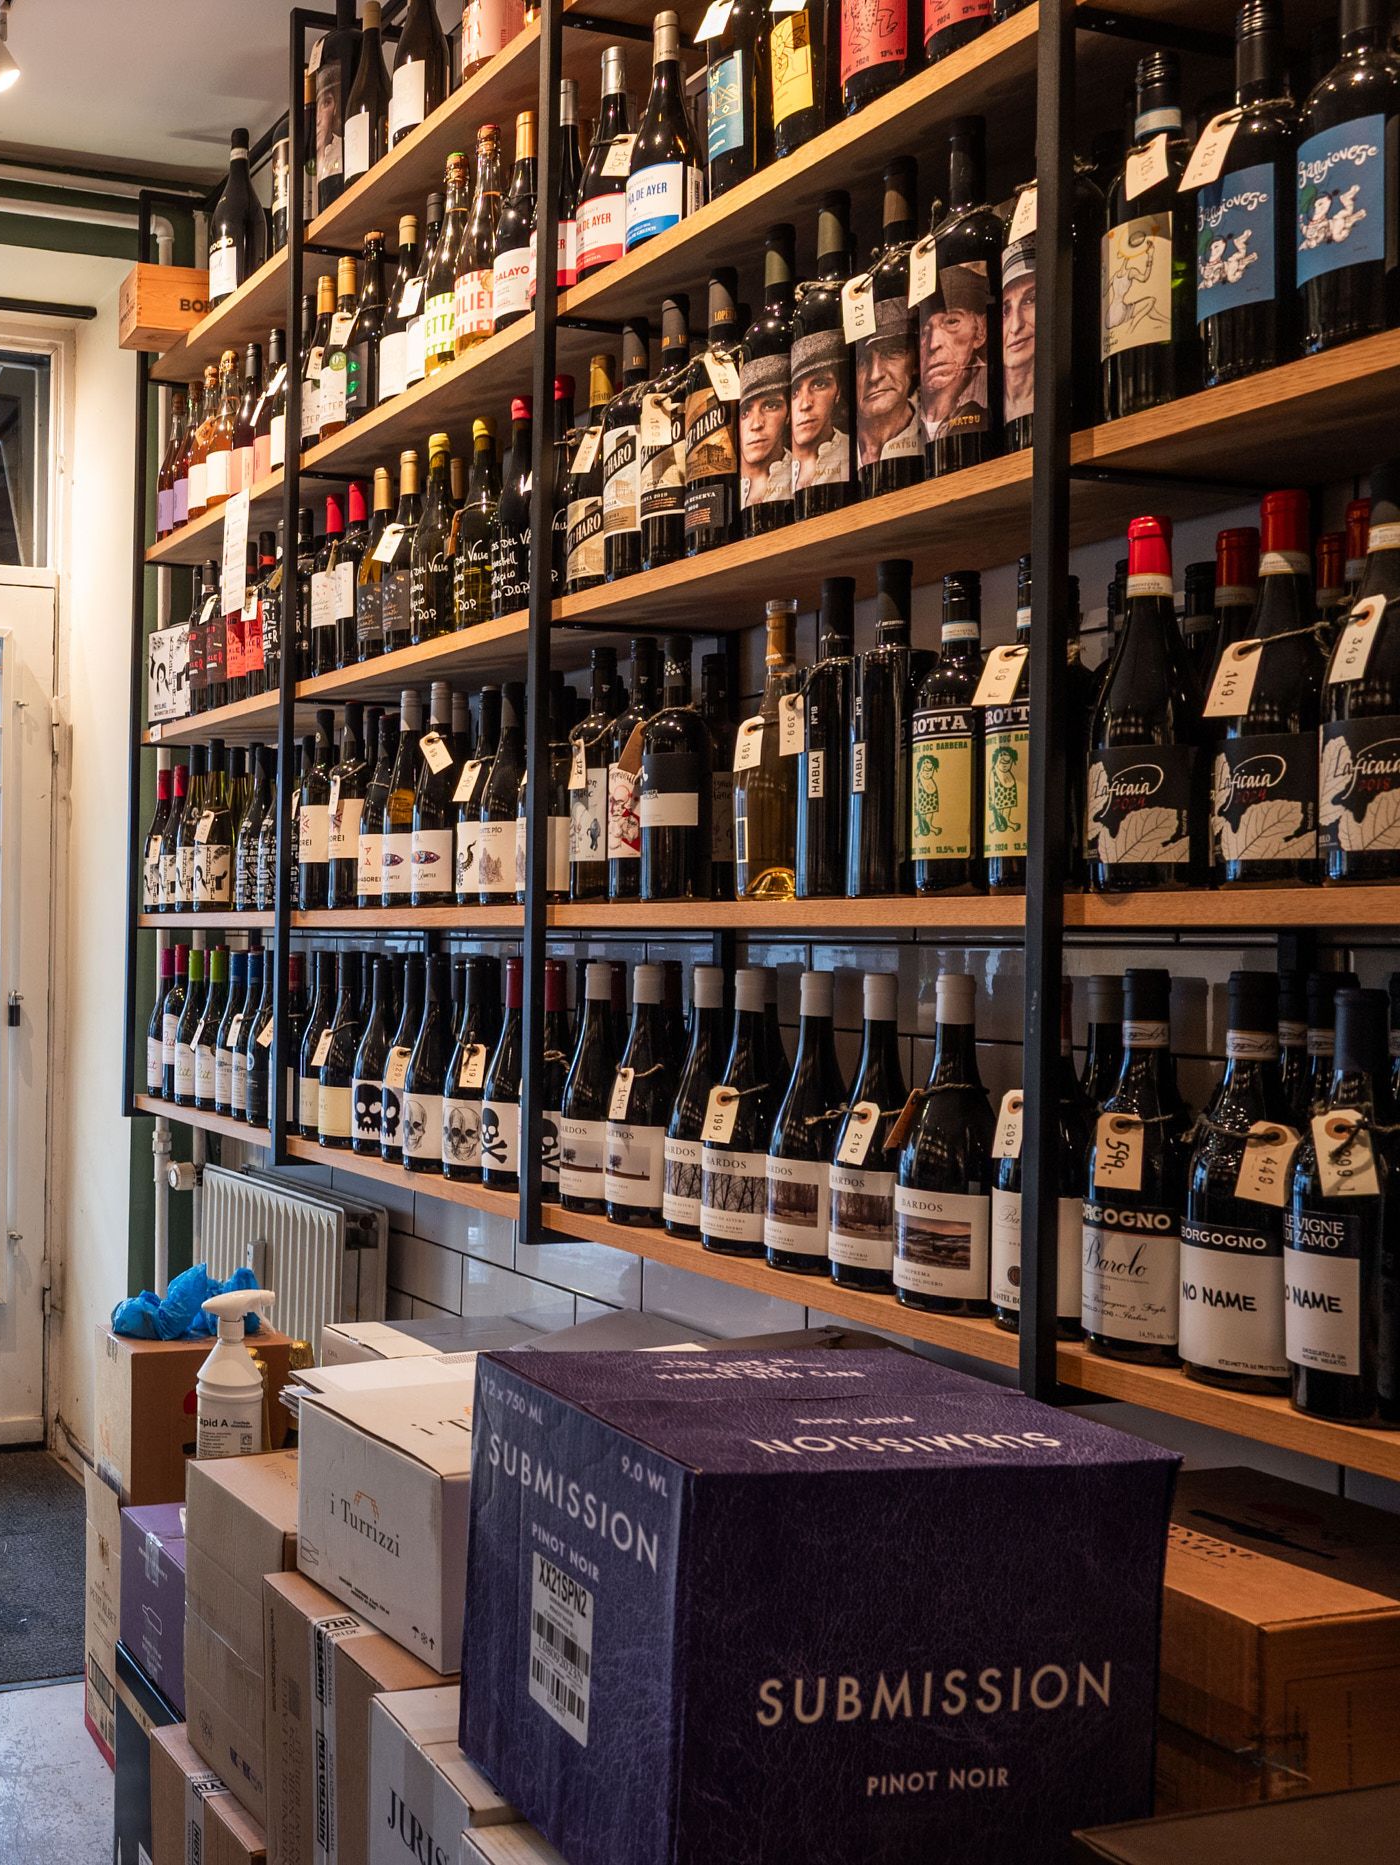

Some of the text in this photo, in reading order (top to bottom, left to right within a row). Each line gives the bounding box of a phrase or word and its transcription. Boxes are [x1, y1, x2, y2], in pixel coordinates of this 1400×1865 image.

[646, 181, 668, 197] AYER
[949, 415, 981, 427] MATSU
[935, 741, 968, 750] BARBERA
[811, 754, 821, 794] HABLA
[855, 748, 863, 787] HABLA
[901, 1197, 943, 1213] BARDOS
[1083, 1203, 1171, 1230] ORGOGNO
[1181, 1227, 1267, 1249] BORGOGNO
[1296, 1214, 1344, 1235] VIGNE
[1083, 1232, 1148, 1277] Barolo
[1182, 1280, 1257, 1312] NO NAME
[1293, 1286, 1343, 1313] NAME
[506, 1390, 526, 1414] 750
[529, 1406, 544, 1425] ML
[221, 1419, 229, 1427] A
[750, 1431, 1062, 1454] SUBMISSION
[621, 1455, 643, 1482] 9.0
[488, 1433, 658, 1574] SUBMISSION
[340, 1497, 401, 1558] Turrizzi
[532, 1521, 600, 1582] PINOT NOIR
[539, 1557, 587, 1619] XX21SPN2
[756, 1660, 1111, 1727] SUBMISSION
[867, 1767, 1009, 1797] PINOT NOIR
